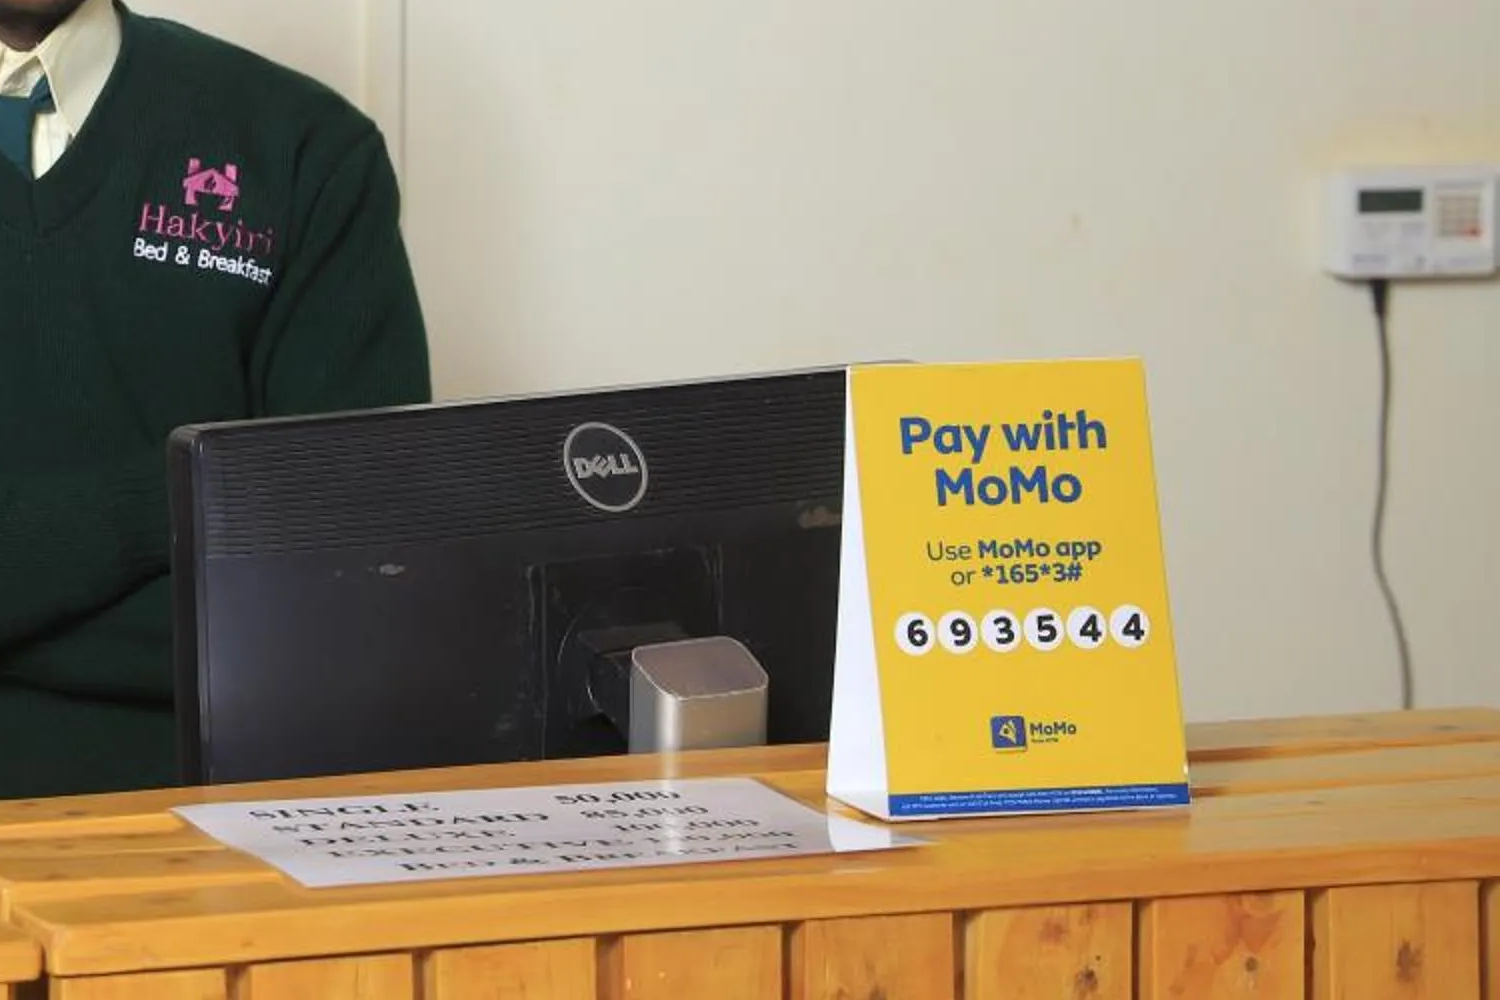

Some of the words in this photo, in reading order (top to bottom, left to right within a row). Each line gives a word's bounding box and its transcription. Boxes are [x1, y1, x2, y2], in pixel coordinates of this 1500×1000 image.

[138, 202, 275, 255] Hakyiri
[132, 237, 169, 262] Bed
[175, 245, 191, 266] &
[197, 249, 274, 286] Breakfast
[899, 415, 991, 464] Pay
[1001, 409, 1108, 453] with
[571, 452, 640, 479] DELL
[934, 465, 1083, 507] MoMo
[926, 540, 973, 561] Use
[977, 537, 1051, 559] MoMo
[1054, 540, 1103, 561] app
[950, 567, 978, 587] or
[1029, 720, 1077, 736] MoMo
[248, 802, 440, 820] SINGLE
[271, 812, 549, 833] STANDARD
